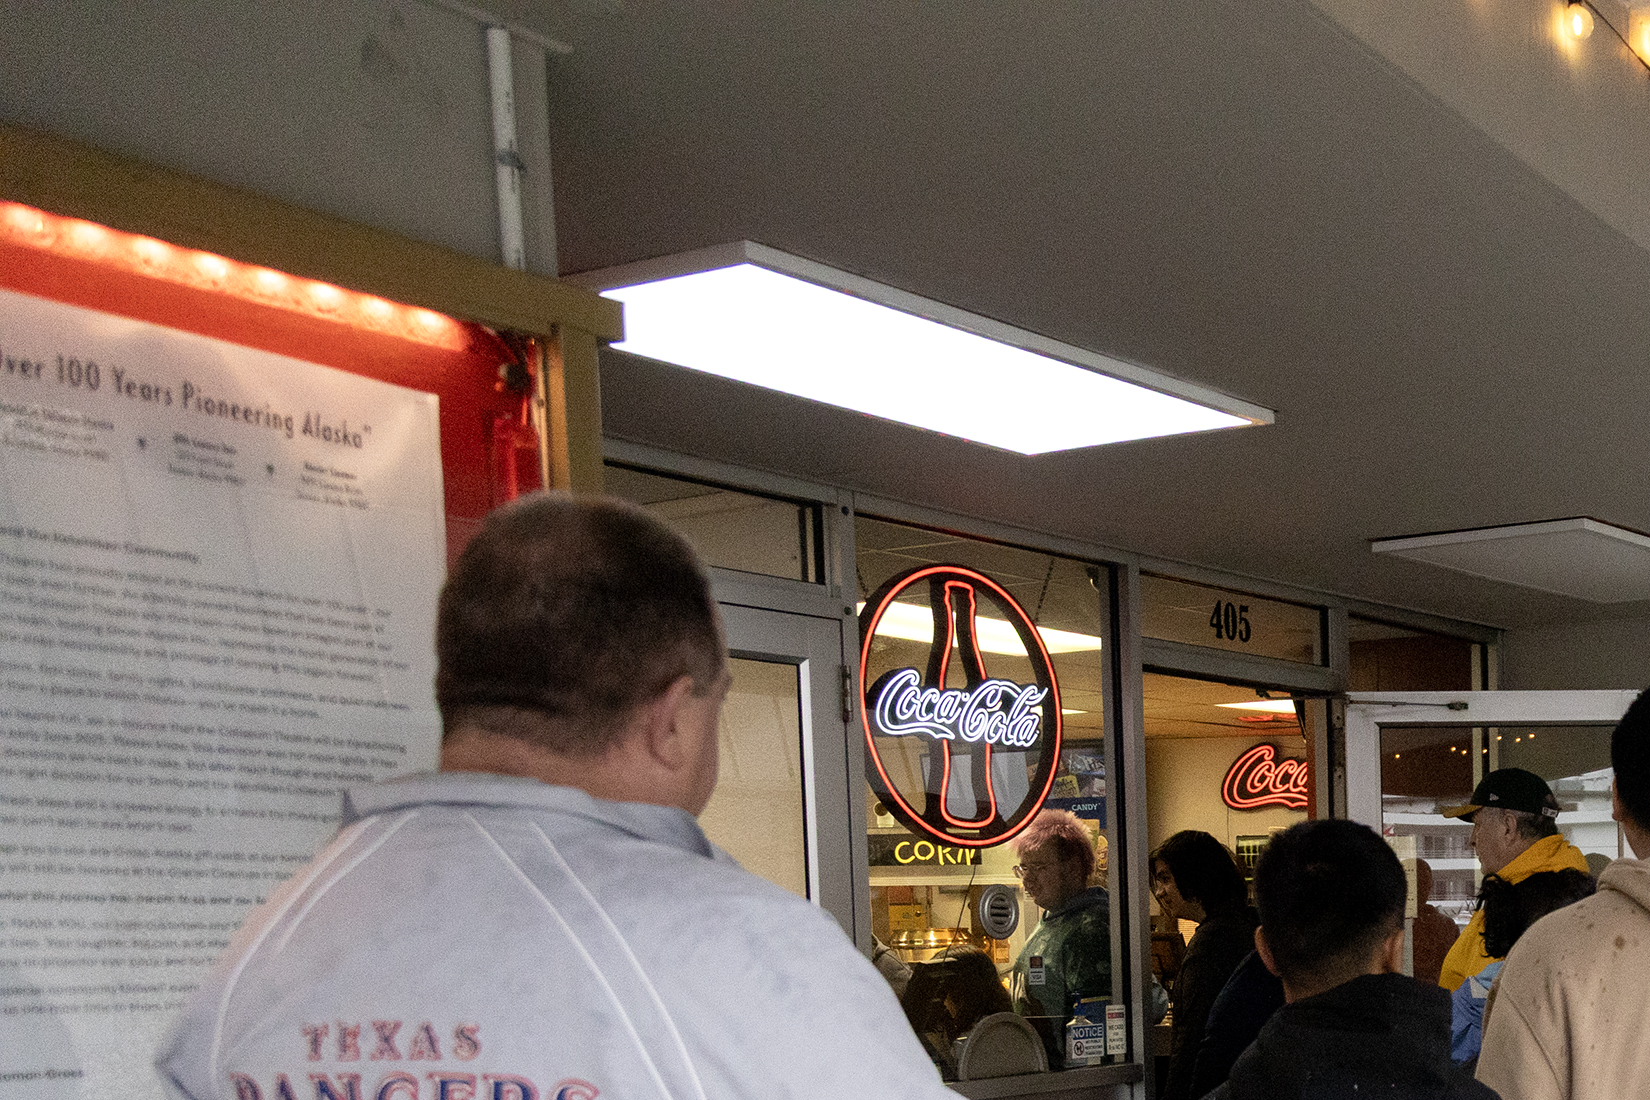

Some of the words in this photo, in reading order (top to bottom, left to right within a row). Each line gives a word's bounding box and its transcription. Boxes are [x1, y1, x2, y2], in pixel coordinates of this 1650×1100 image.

[0, 351, 44, 381] ver
[55, 353, 102, 391] 100
[112, 364, 173, 408] Years
[181, 378, 295, 440] Pioneering
[1209, 600, 1252, 643] 405
[1071, 803, 1098, 812] CANDY
[300, 1019, 483, 1062] TEXAS
[1072, 1026, 1103, 1038] NOTICE
